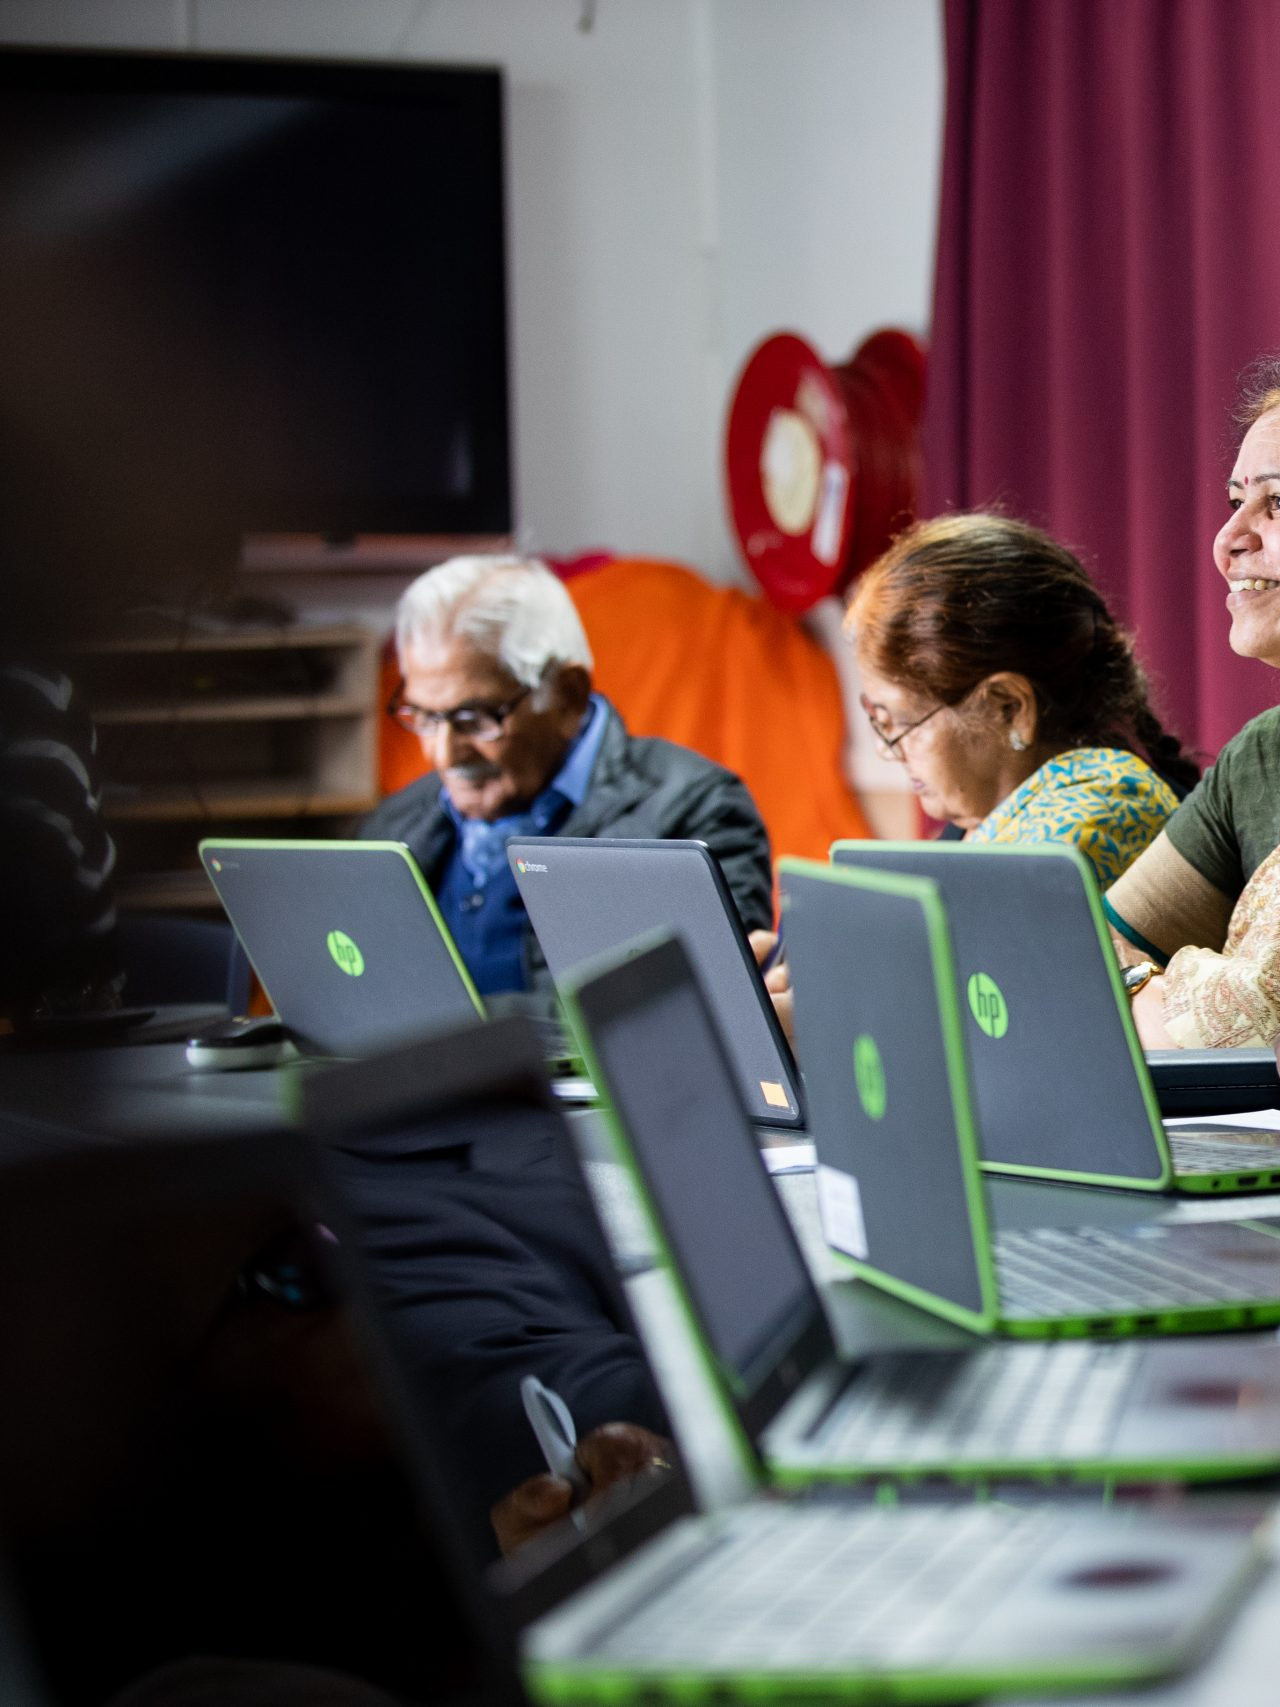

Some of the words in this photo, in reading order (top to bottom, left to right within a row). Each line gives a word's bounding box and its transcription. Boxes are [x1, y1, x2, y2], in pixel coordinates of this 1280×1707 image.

[525, 861, 548, 873] chrome
[331, 930, 359, 976] hp
[974, 972, 1002, 1038] hp
